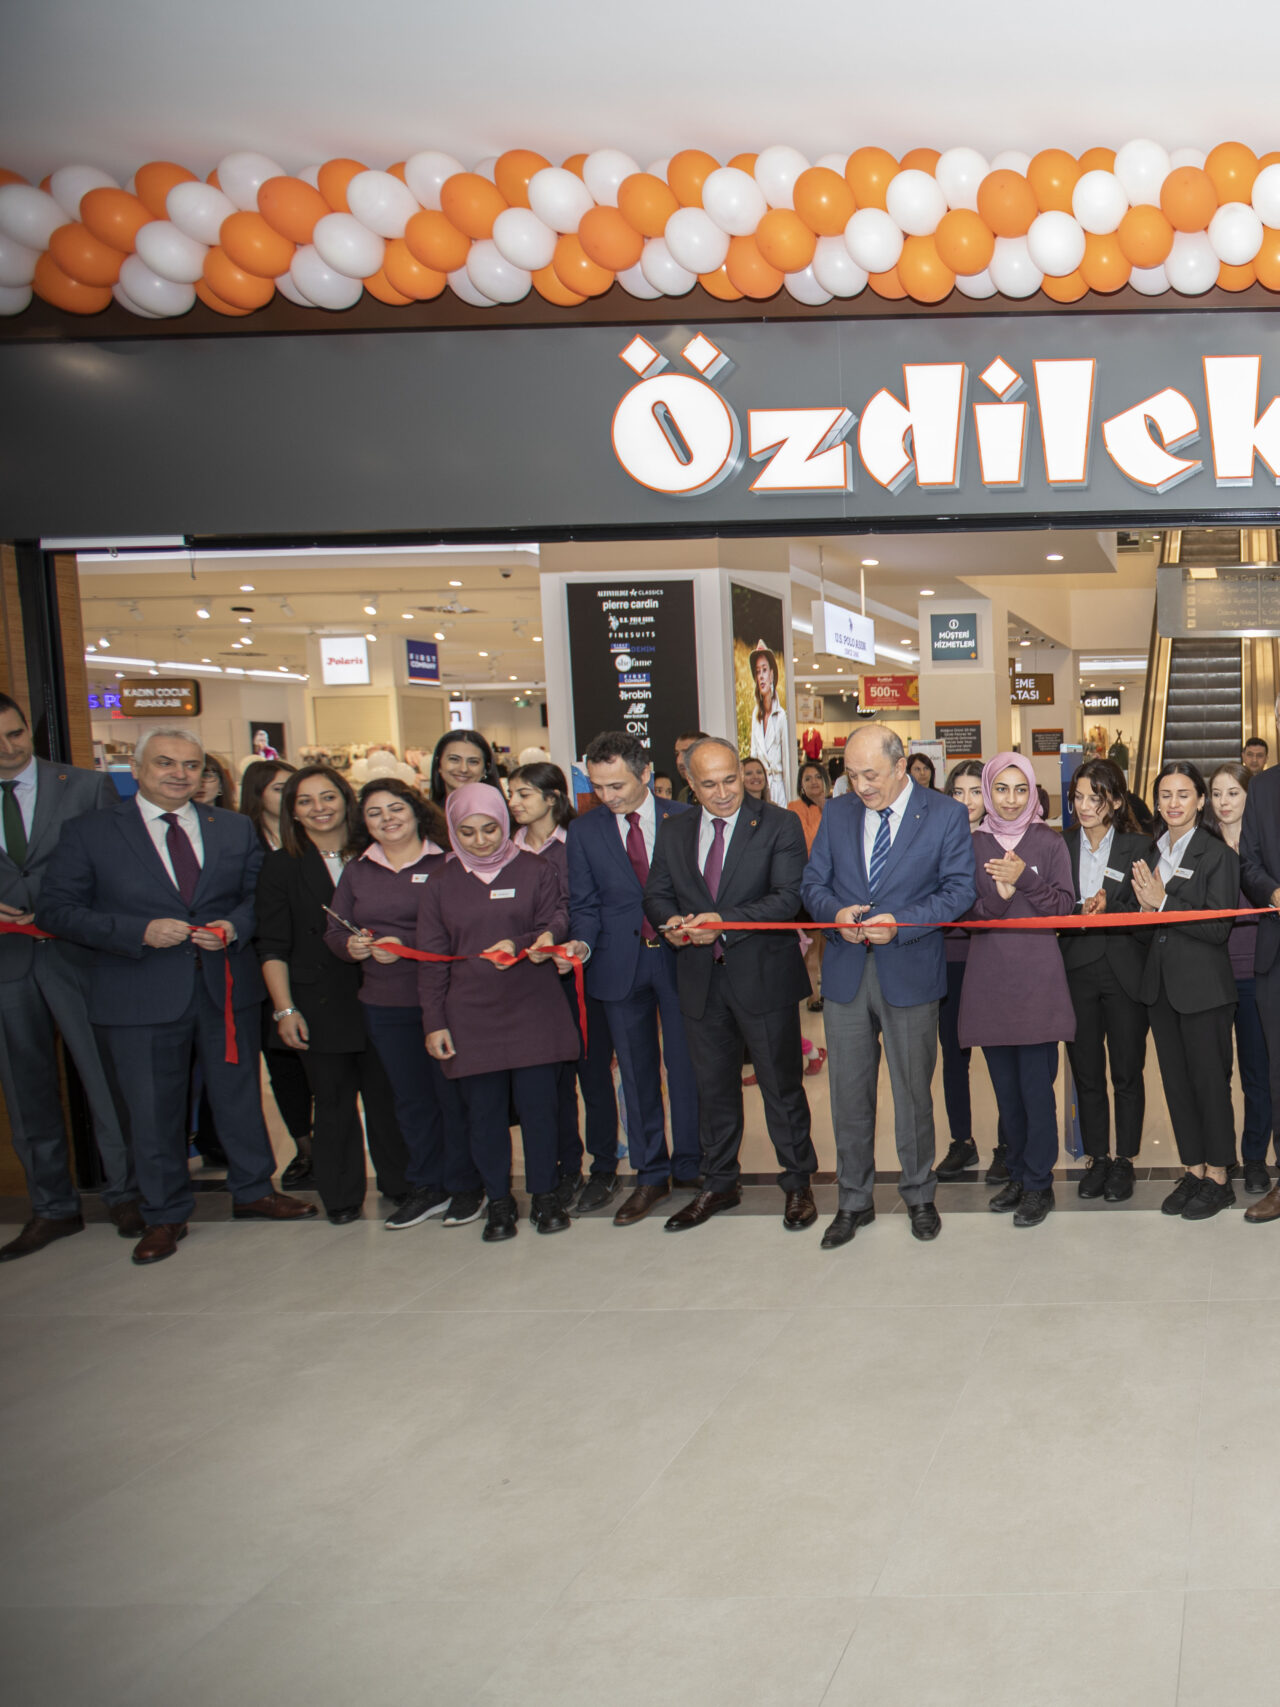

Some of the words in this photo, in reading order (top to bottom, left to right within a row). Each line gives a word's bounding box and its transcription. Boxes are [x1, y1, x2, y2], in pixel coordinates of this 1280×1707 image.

[602, 599, 629, 612] pierre
[630, 598, 659, 609] cardin
[938, 630, 970, 640] MÜŞTERİ
[934, 639, 975, 649] HİZMETLERİ
[327, 657, 363, 665] Polaris
[409, 653, 437, 662] FIRST
[123, 687, 155, 697] KADIN
[628, 689, 652, 699] robin
[1084, 696, 1119, 707] cardin
[626, 721, 648, 733] ON
